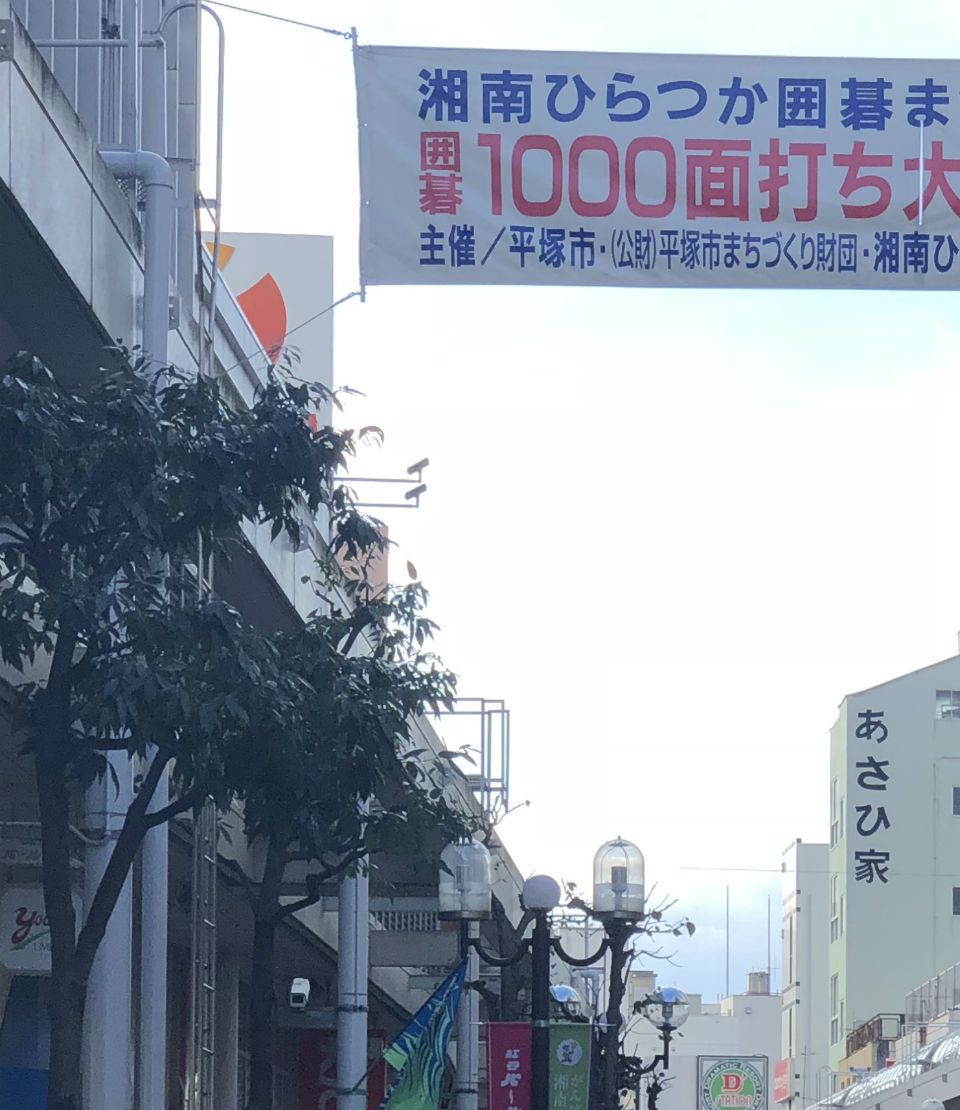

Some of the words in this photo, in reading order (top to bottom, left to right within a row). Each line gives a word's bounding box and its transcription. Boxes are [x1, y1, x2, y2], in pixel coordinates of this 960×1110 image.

[418, 131, 463, 216] 囲碁
[854, 709, 891, 884] あさひ家
